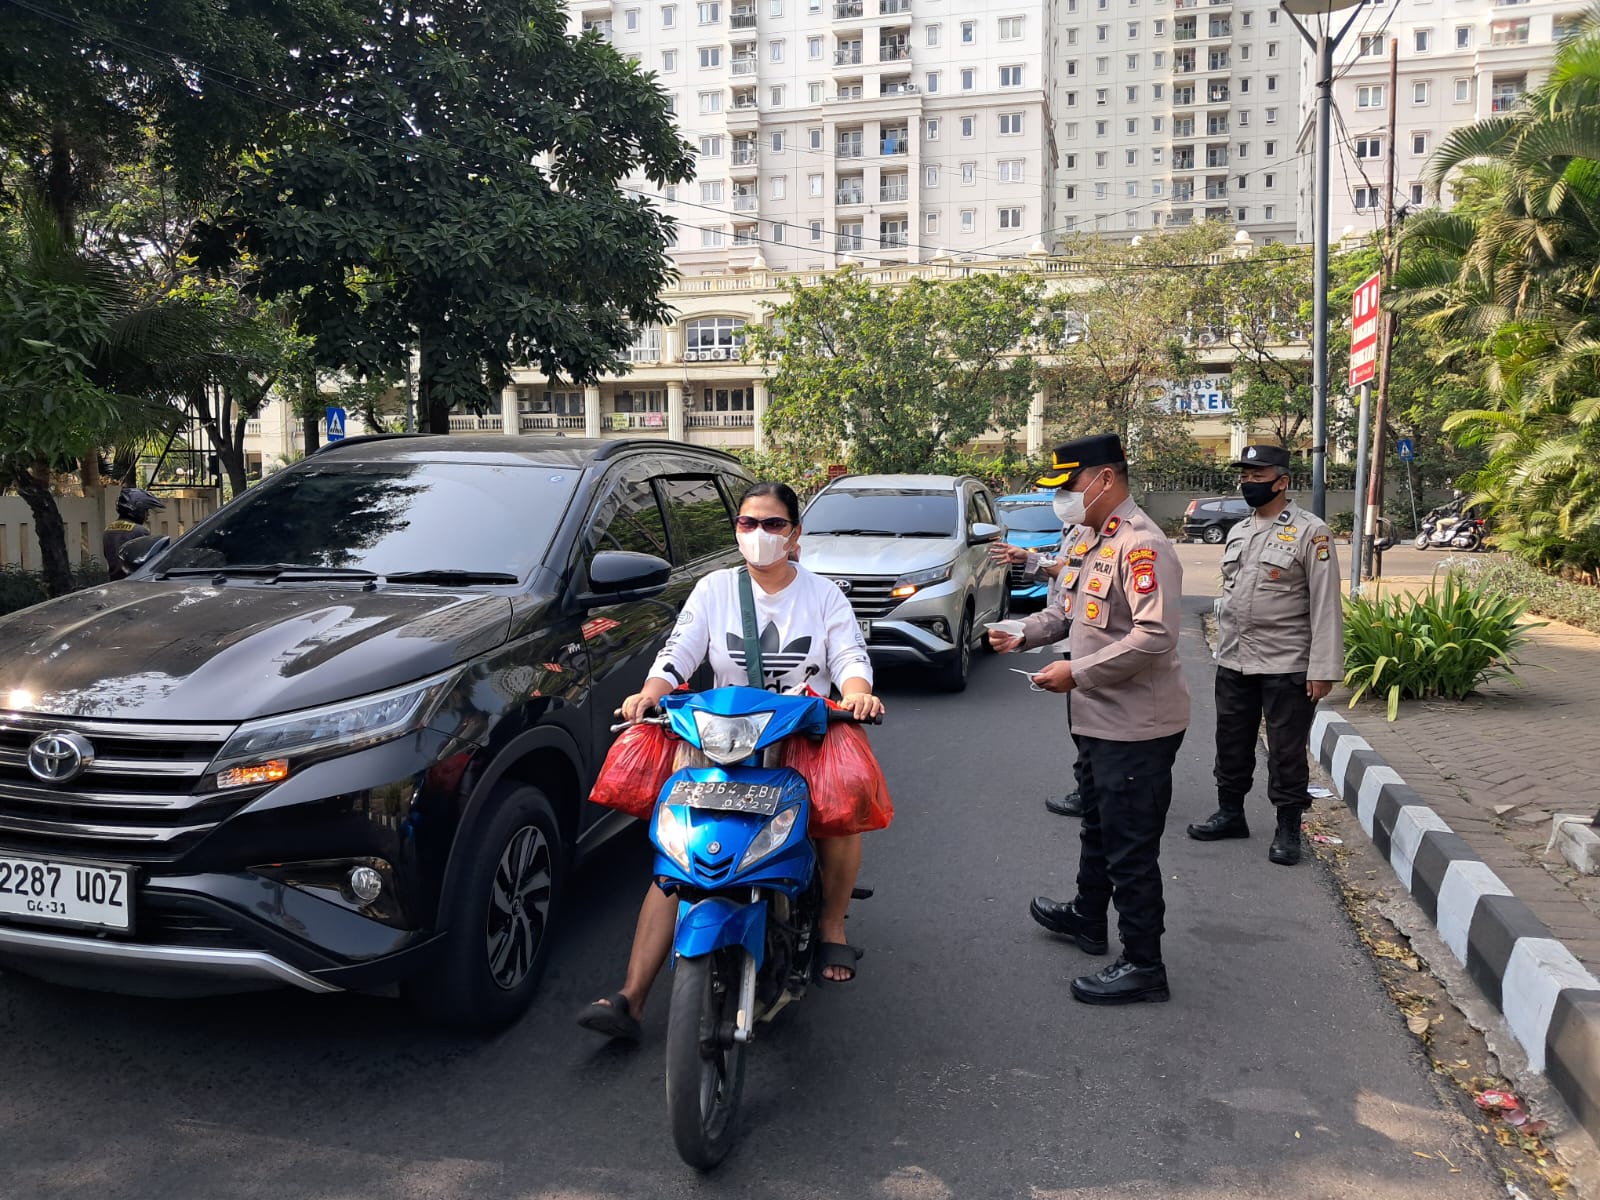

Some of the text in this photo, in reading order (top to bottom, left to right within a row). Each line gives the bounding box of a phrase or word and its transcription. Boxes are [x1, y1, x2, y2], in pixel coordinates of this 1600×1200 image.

[1267, 542, 1297, 553] POLRI
[1093, 561, 1113, 575] POLRI
[0, 862, 122, 907] 2287 UOZ
